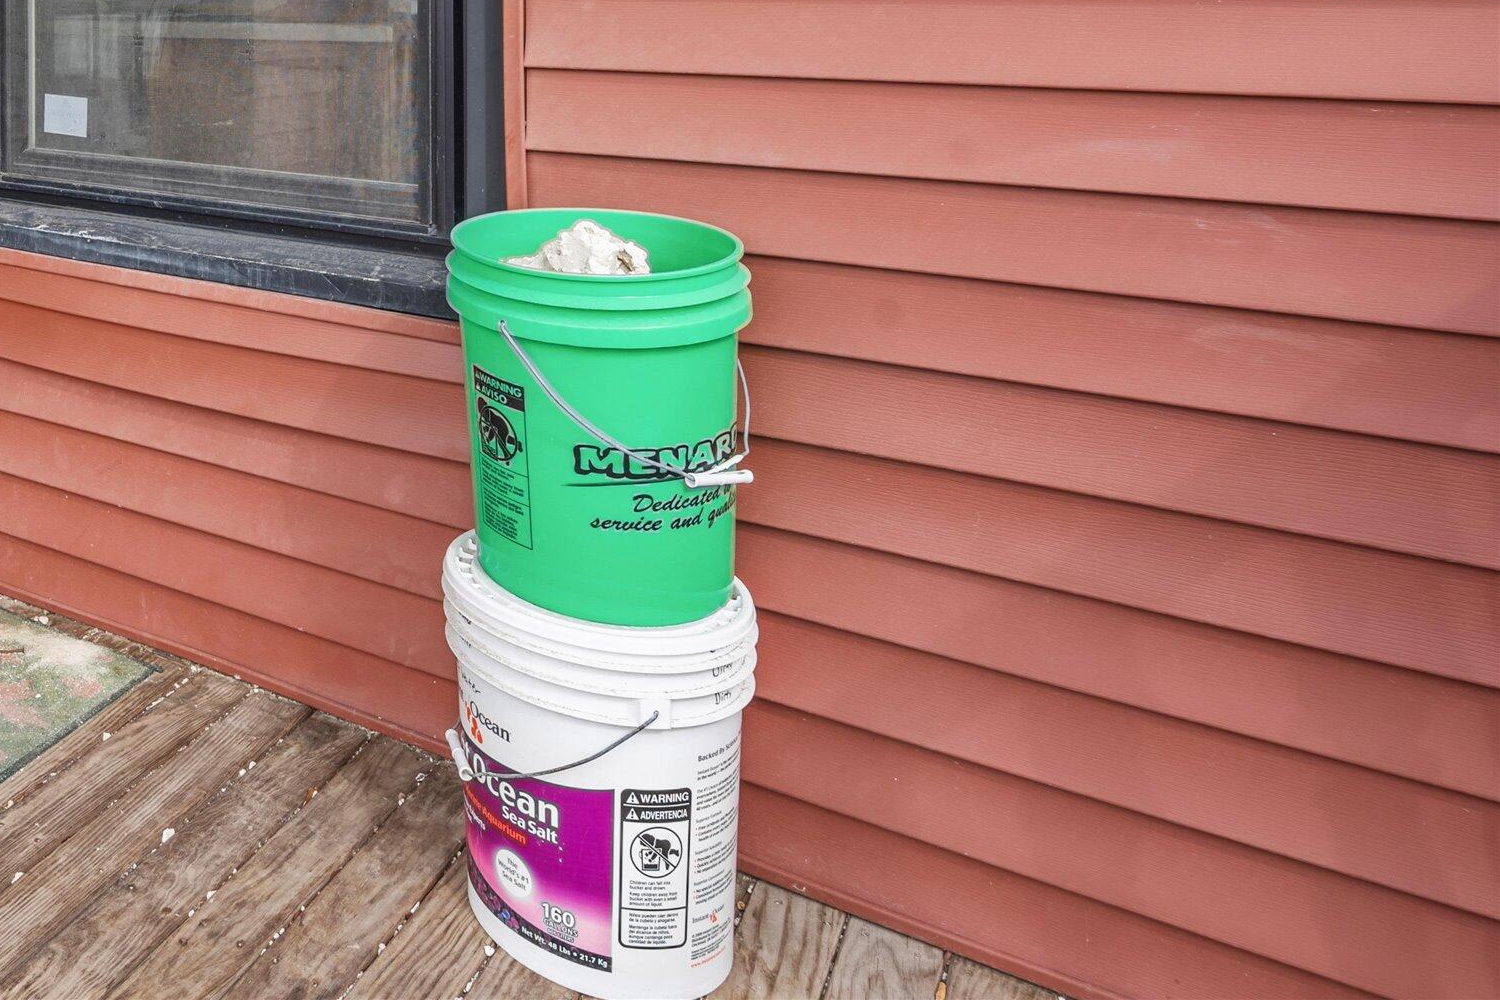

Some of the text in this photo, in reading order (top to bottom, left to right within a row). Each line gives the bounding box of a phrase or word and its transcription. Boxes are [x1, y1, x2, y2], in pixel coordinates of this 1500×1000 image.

[480, 373, 522, 397] WARNING
[481, 384, 508, 404] AVISO
[632, 485, 720, 513] Dedicated
[590, 516, 663, 532] service
[670, 508, 704, 531] and
[470, 700, 511, 743] Ocean
[473, 752, 560, 829] Ocean
[640, 791, 689, 803] WARNING
[482, 806, 527, 845] Aquarium
[502, 805, 526, 830] Sea
[527, 821, 559, 844] Salt
[640, 808, 688, 820] ADVERTENCIA
[541, 902, 576, 928] 160
[521, 926, 533, 938] Net
[548, 941, 557, 950] 48
[559, 945, 571, 956] Lbs
[579, 953, 596, 964] 21.7
[597, 958, 608, 968] Kg
